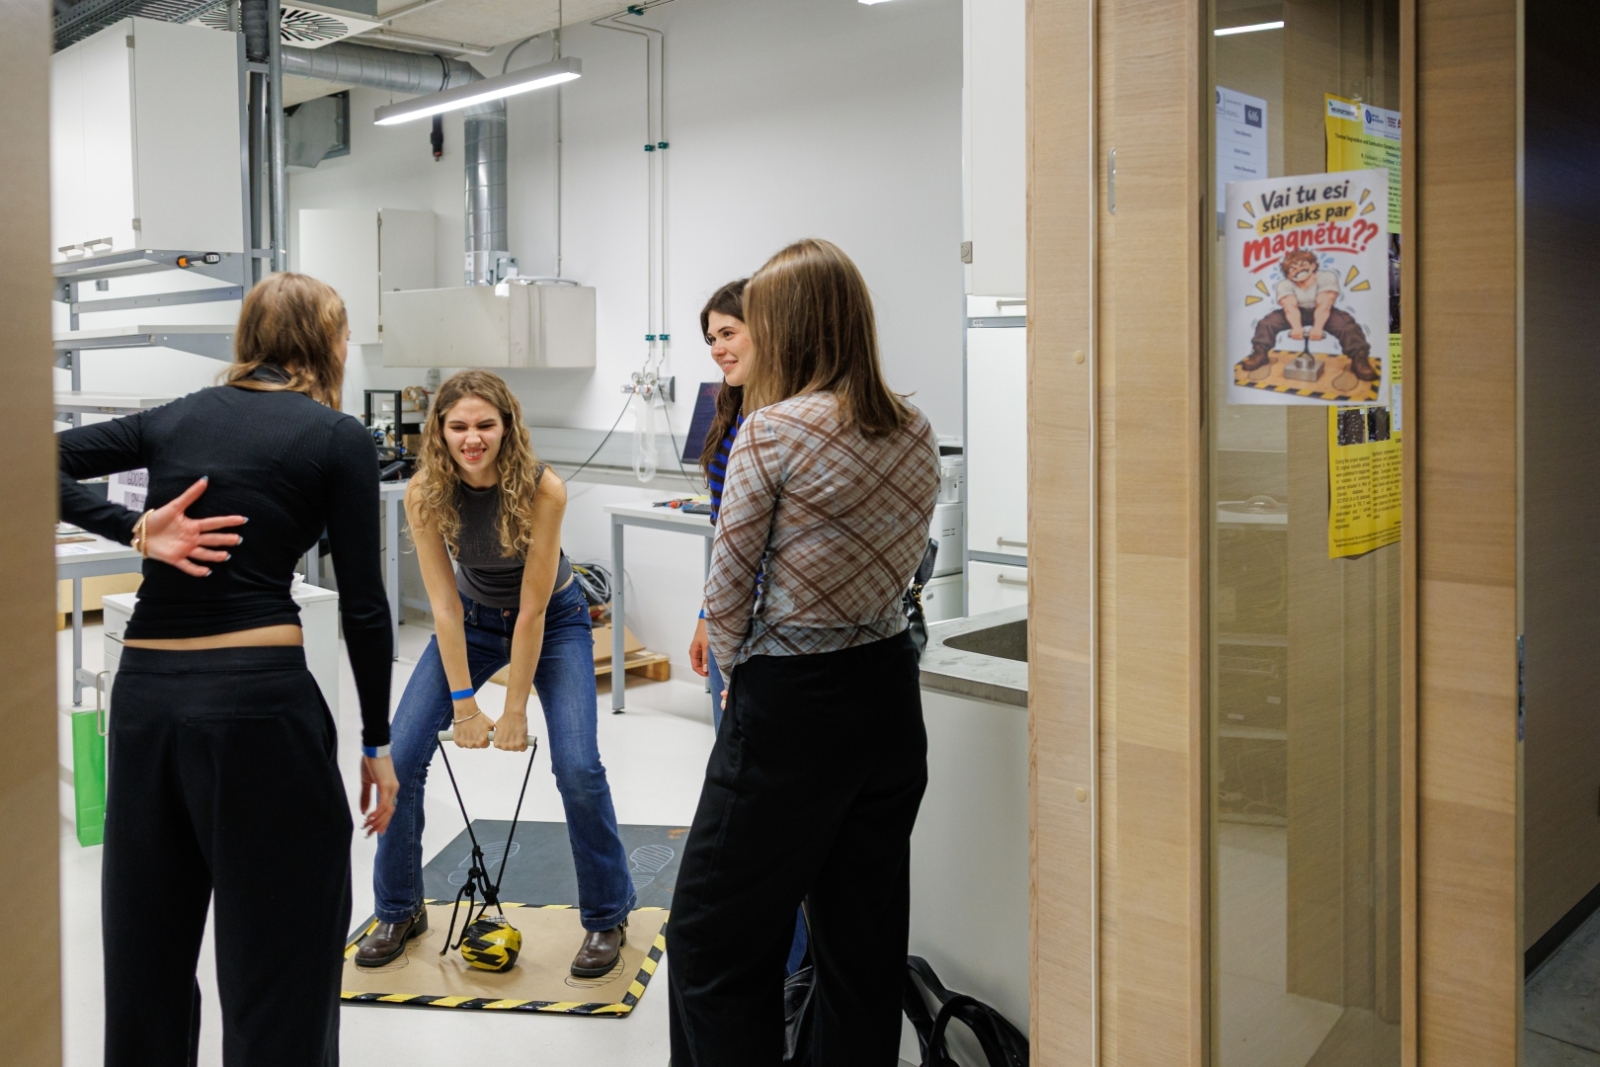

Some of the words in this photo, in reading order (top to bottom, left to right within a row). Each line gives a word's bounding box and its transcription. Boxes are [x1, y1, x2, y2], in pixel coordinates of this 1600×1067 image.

[1261, 187, 1291, 212] Vai
[1296, 185, 1316, 204] tu
[1323, 180, 1349, 199] esi
[1262, 207, 1321, 233] stiprāks
[1326, 205, 1352, 222] par
[1243, 219, 1379, 268] magnētu??
